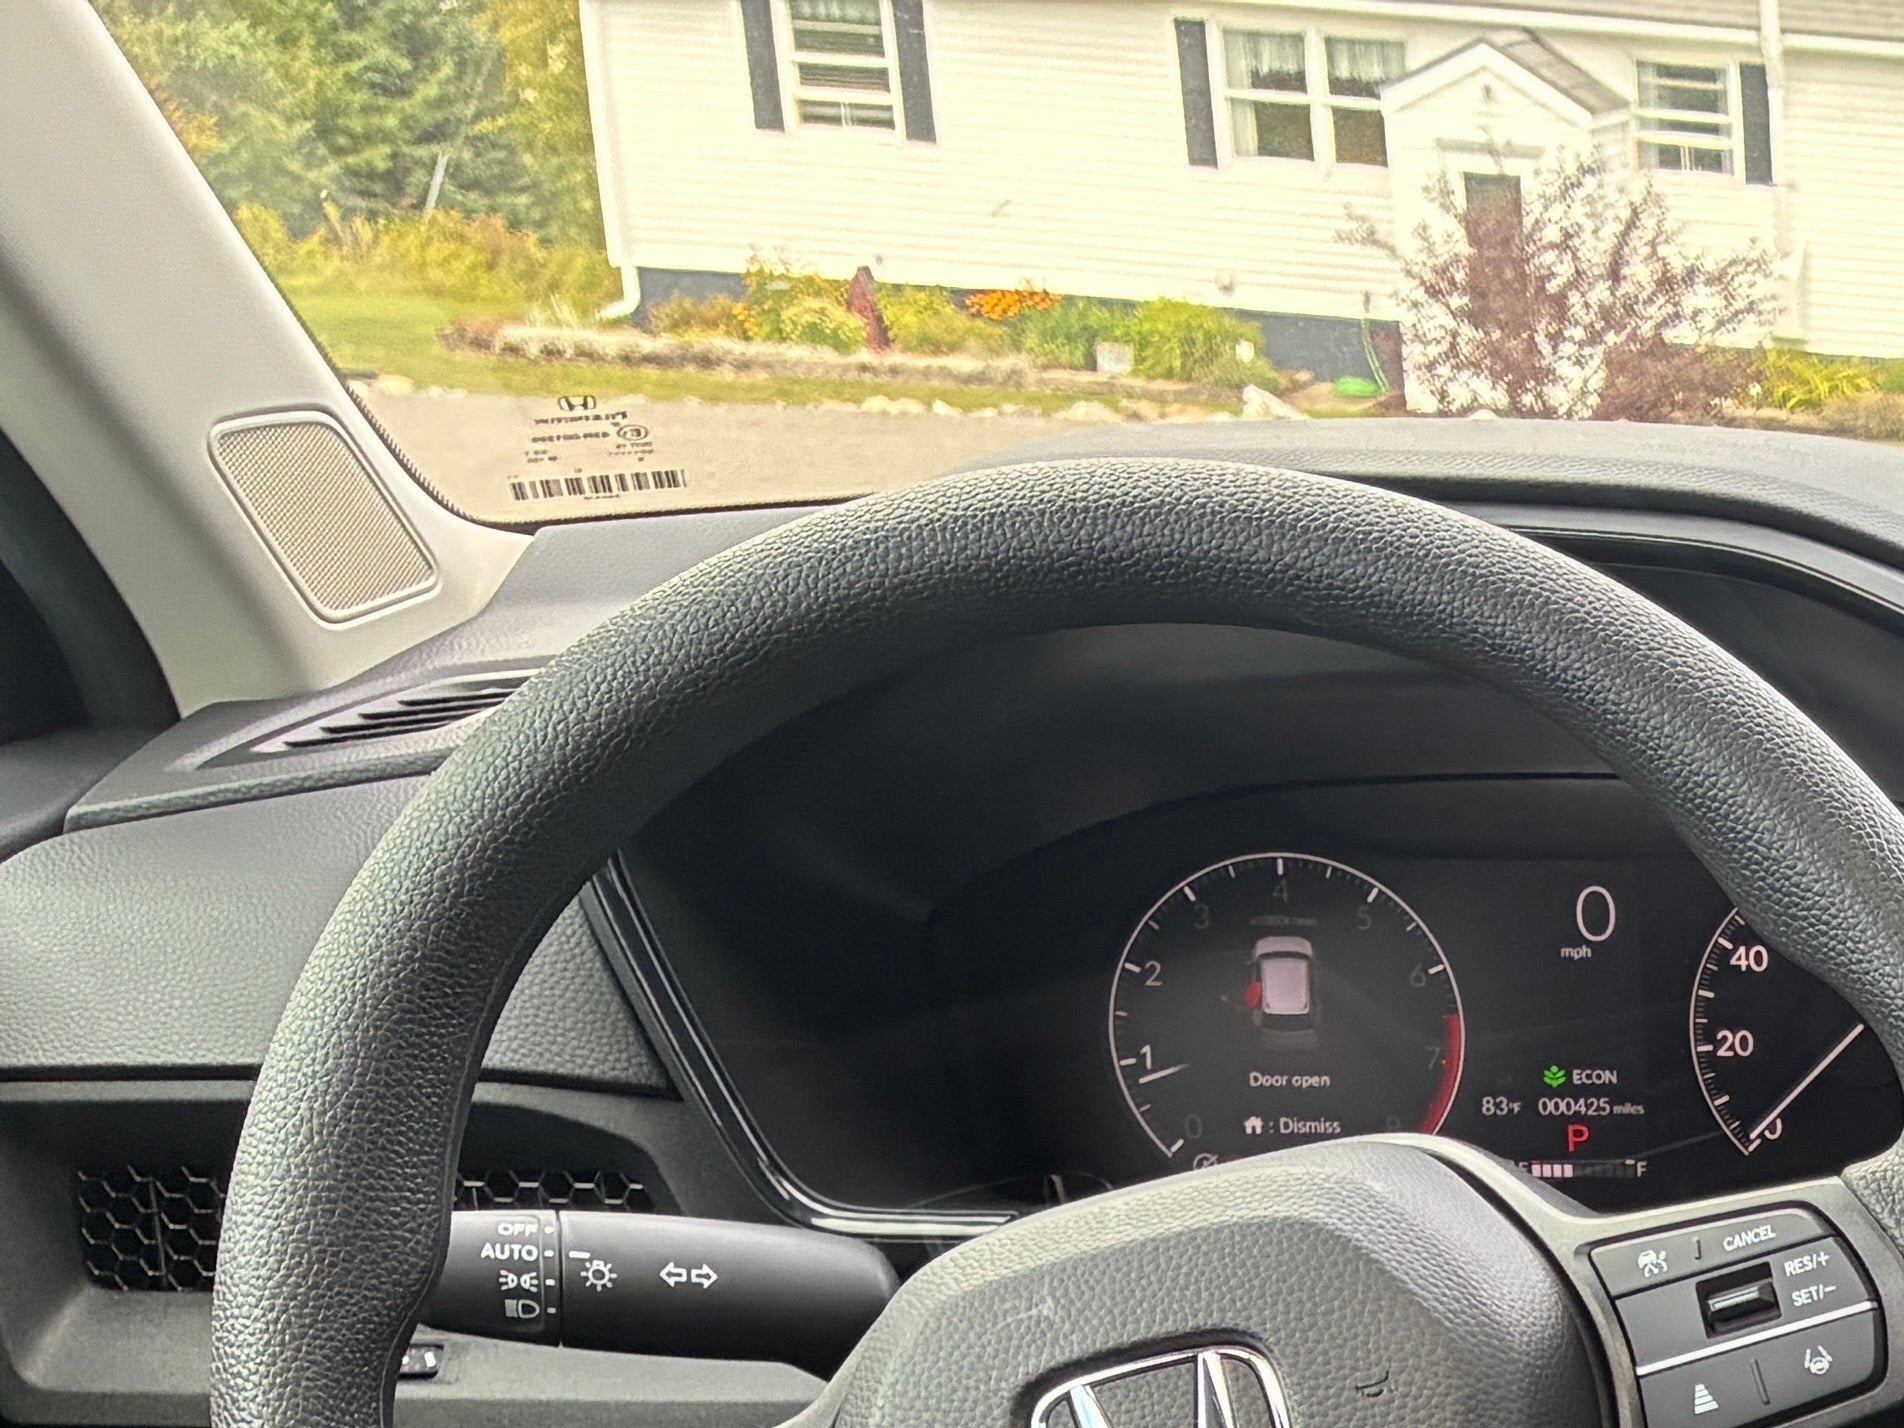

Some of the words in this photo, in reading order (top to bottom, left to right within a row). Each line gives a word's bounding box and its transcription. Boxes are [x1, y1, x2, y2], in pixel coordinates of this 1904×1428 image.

[1271, 878, 1290, 903] 4
[1193, 904, 1211, 930] 3
[1354, 907, 1373, 931] 5
[1575, 884, 1617, 942] 0
[1560, 944, 1592, 961] mph
[1729, 944, 1769, 973] 40
[1143, 960, 1163, 987] 2
[1409, 963, 1427, 988] 6
[1715, 1029, 1755, 1057] 20
[1139, 1043, 1153, 1070] 1
[1249, 1071, 1289, 1087] Door
[1291, 1073, 1331, 1093] open
[1572, 1068, 1618, 1085] ECON
[1537, 1097, 1611, 1116] 000425
[1612, 1102, 1646, 1115] miles
[1279, 1116, 1342, 1135] Dismiss
[1567, 1123, 1590, 1152] P
[1636, 1161, 1648, 1178] F
[497, 1221, 538, 1237] OFF
[1722, 1223, 1777, 1252] CANCEL
[480, 1243, 539, 1261] AUTO
